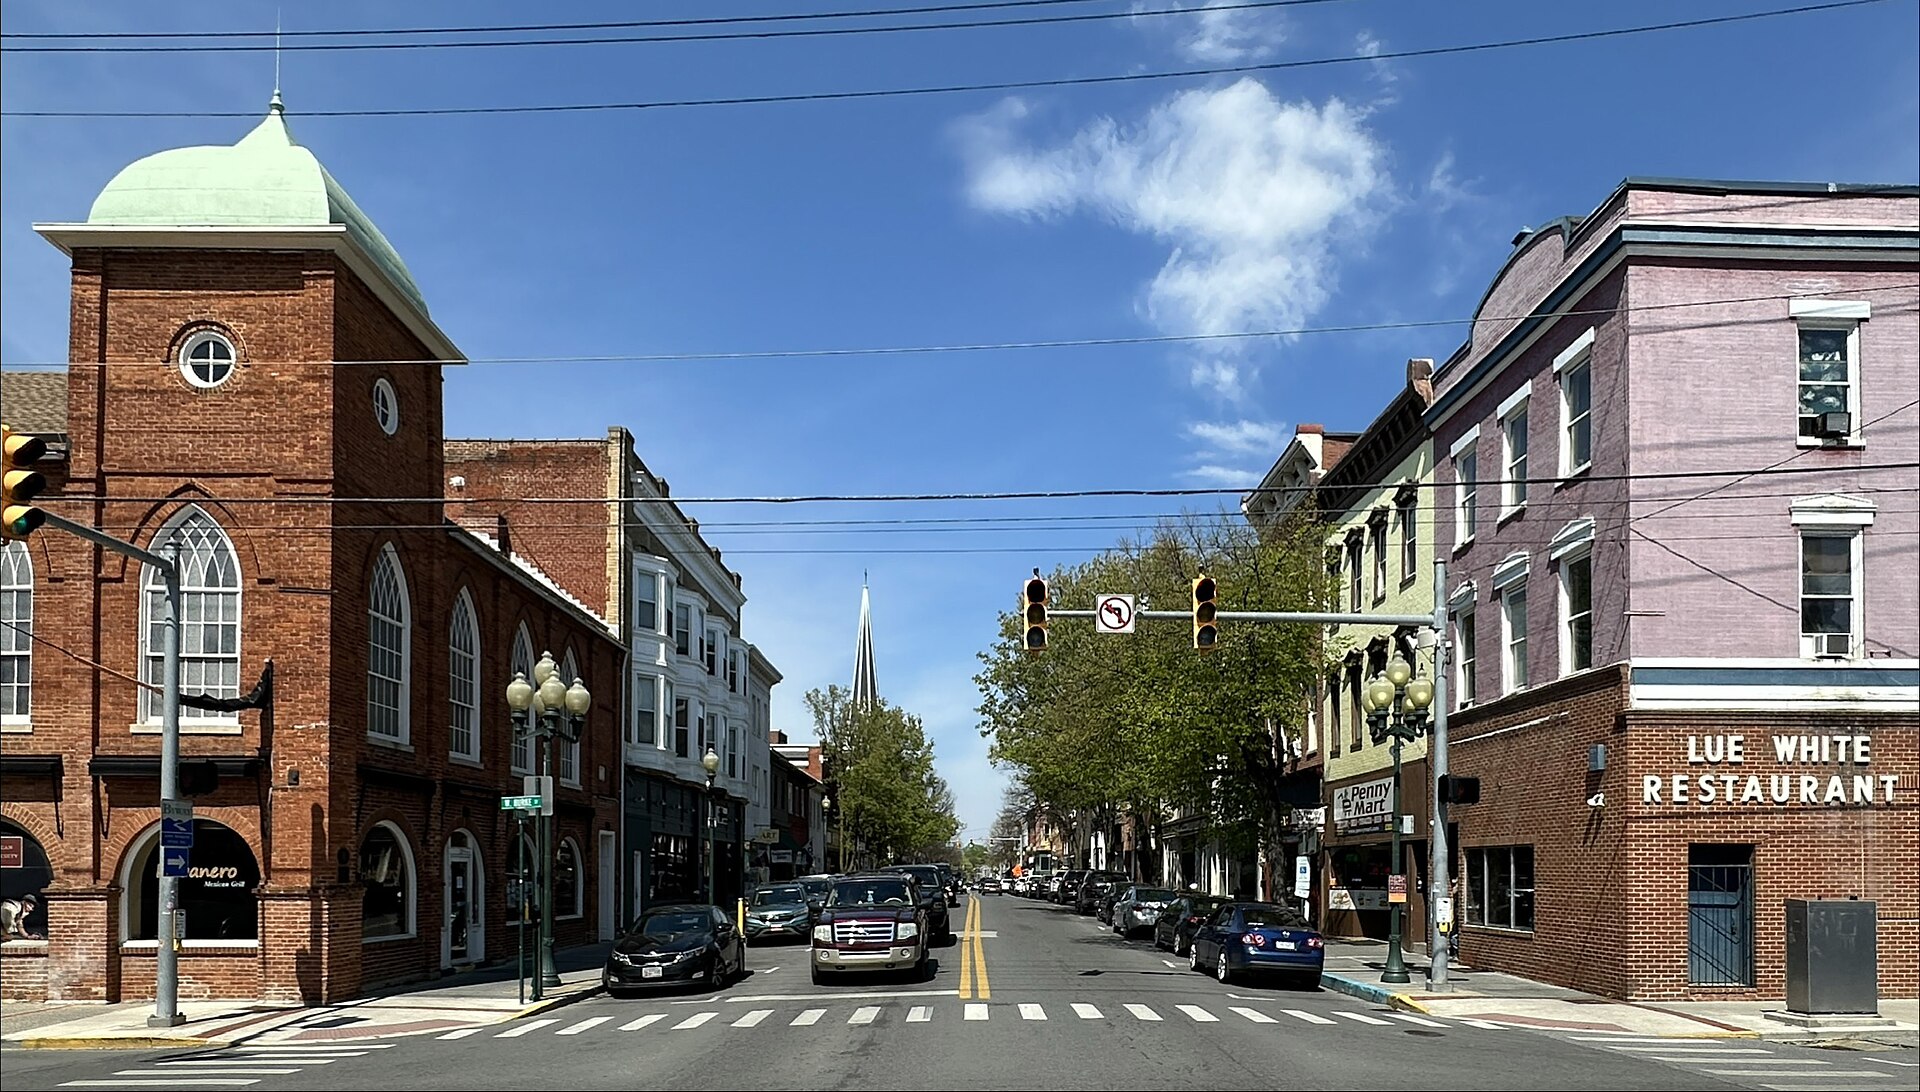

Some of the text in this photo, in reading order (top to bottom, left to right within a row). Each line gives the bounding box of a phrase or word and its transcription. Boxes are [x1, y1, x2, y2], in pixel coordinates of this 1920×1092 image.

[1687, 735, 1871, 764] LUE WHITE
[1351, 782, 1391, 801] Penny
[1642, 774, 1899, 804] RESTAURANT
[1354, 798, 1386, 816] Mart
[761, 832, 777, 840] ART
[203, 880, 246, 888] Mexican Grill
